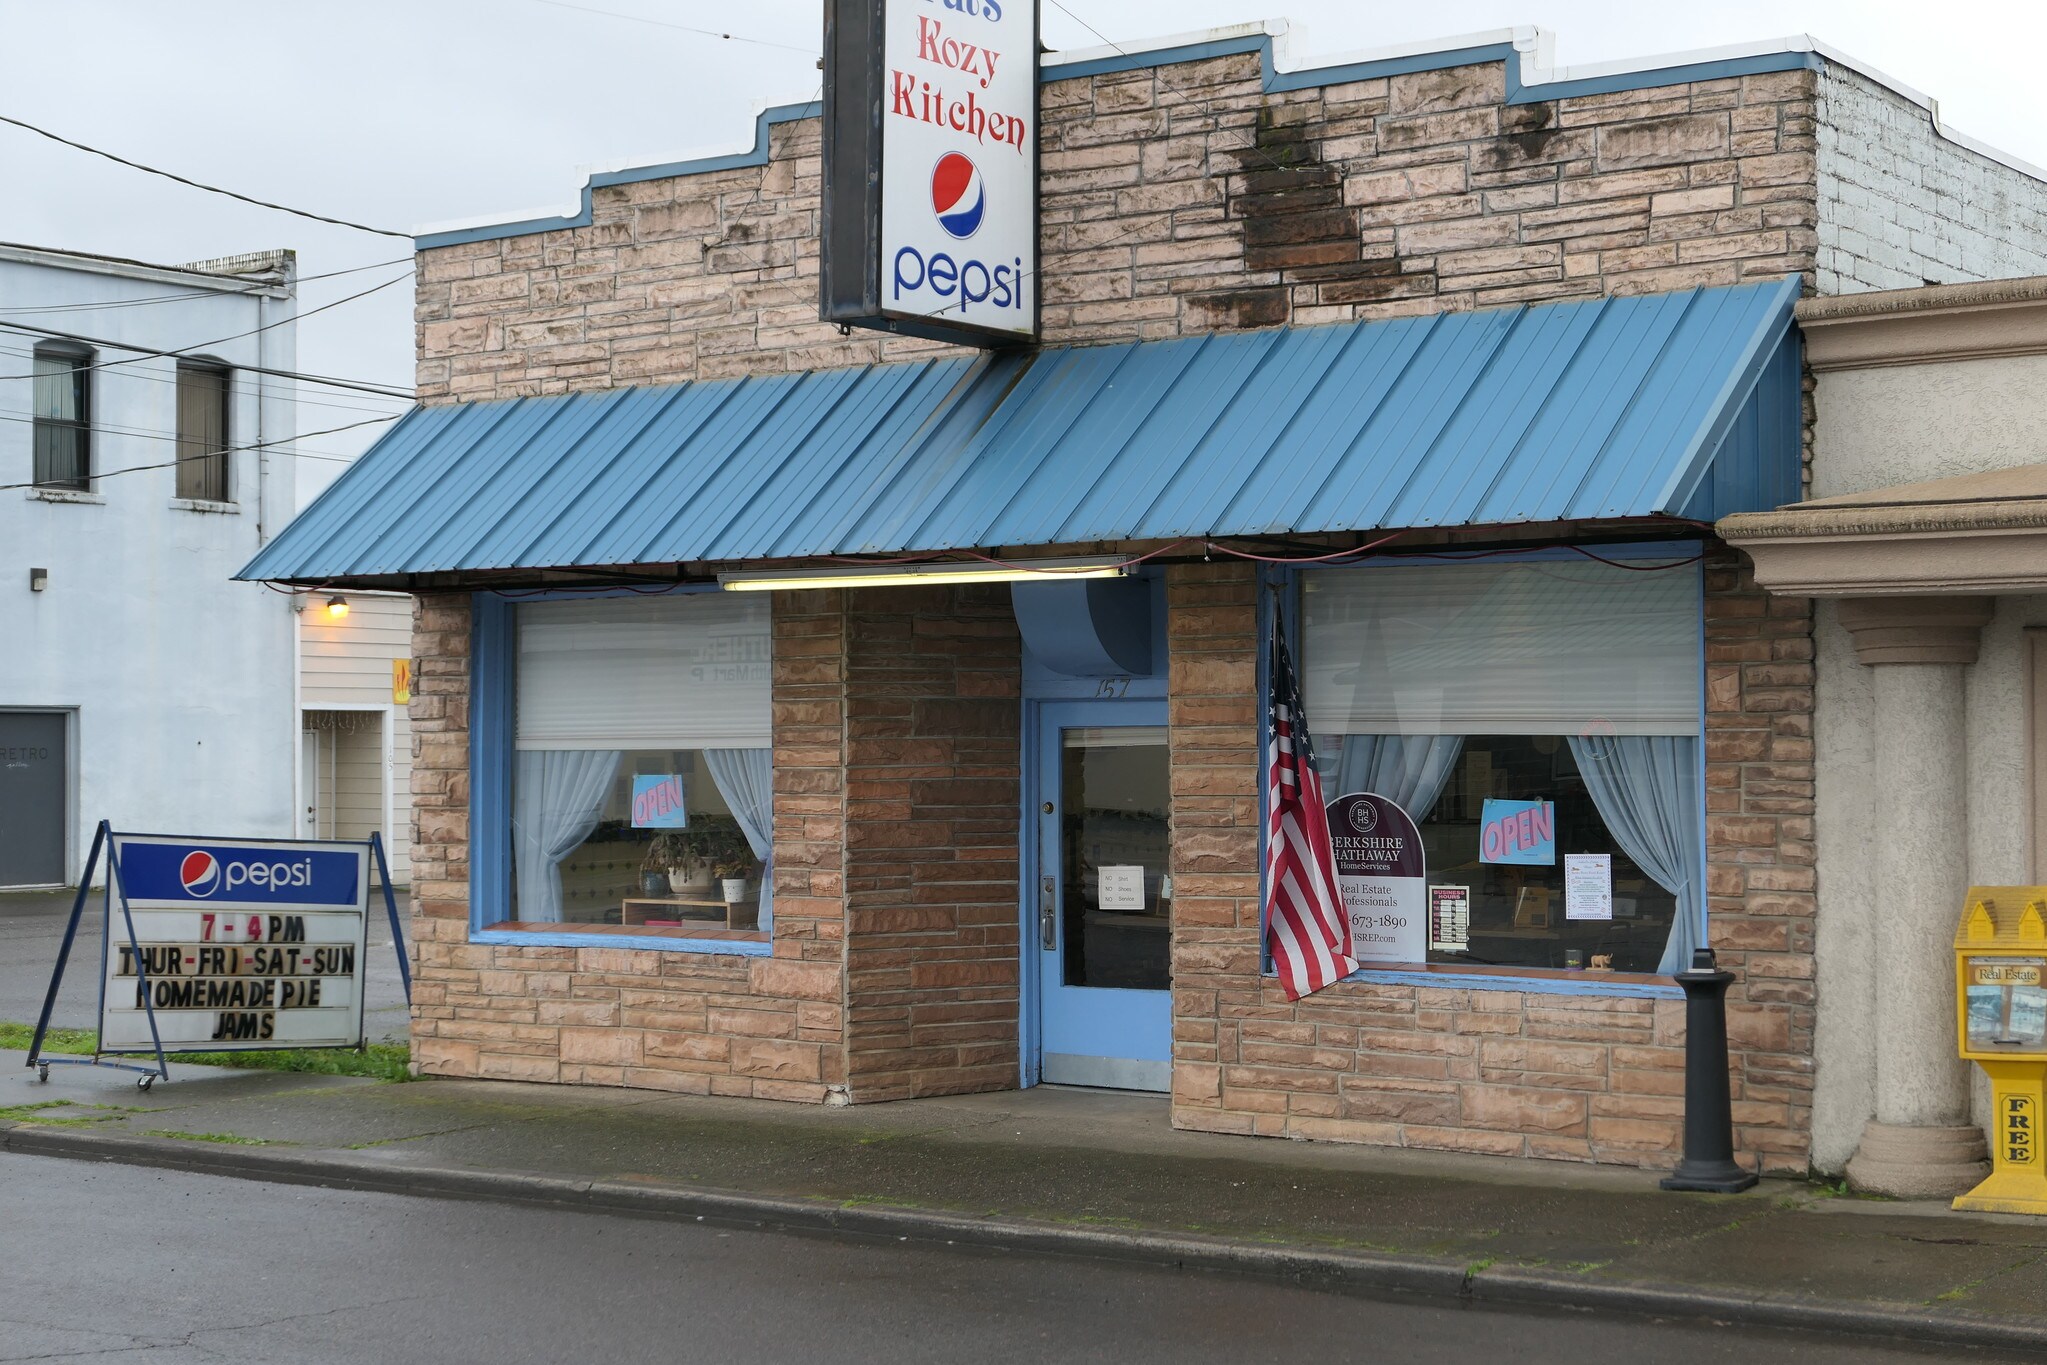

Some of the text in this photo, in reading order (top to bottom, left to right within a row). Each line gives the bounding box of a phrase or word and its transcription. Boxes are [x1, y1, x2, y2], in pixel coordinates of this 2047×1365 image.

[916, 14, 1001, 89] Kozy
[890, 69, 1025, 156] Kitchen
[894, 246, 1021, 313] pepsi
[1096, 679, 1131, 698] 157
[0, 747, 48, 760] RETRO
[634, 776, 683, 826] OPEN
[1357, 809, 1369, 817] BH
[1357, 816, 1369, 824] HS
[1482, 803, 1553, 862] OPEN
[225, 858, 311, 892] pepsi
[1340, 862, 1391, 870] HomeServices
[1362, 884, 1392, 895] Estate
[1349, 913, 1407, 930] 673-1890
[1979, 968, 2037, 981] Real Estate
[281, 979, 321, 1006] PIE
[212, 1012, 274, 1040] JAMS
[2008, 1098, 2031, 1162] FREE
